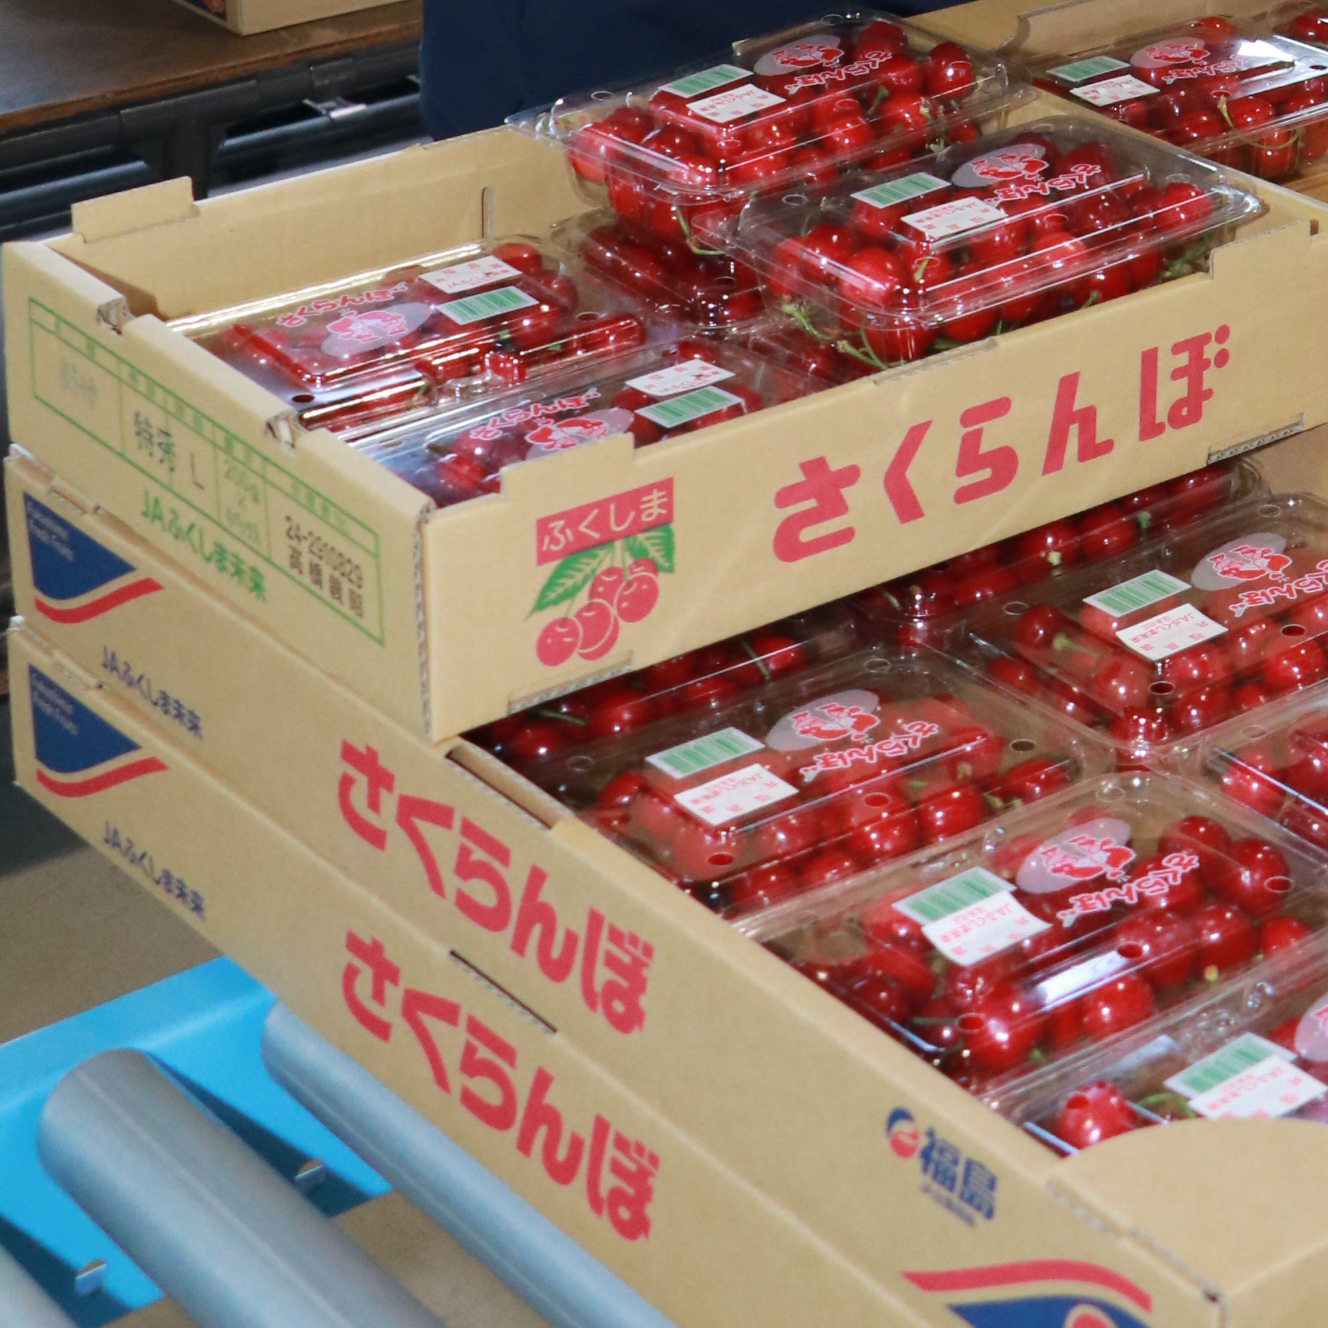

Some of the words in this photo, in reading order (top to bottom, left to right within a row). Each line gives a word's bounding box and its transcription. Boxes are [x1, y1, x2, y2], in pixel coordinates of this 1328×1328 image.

[785, 50, 892, 92] さくらんぼ
[986, 163, 1101, 204] さくらんぼ
[276, 282, 408, 327] さくらんぼ
[469, 389, 601, 440] さくらんぼ
[772, 324, 1230, 562] さくらんぼ
[141, 488, 267, 602] JAふくしま未来
[541, 487, 670, 551] ふくしま
[798, 721, 939, 778] さくらんぼ
[338, 739, 653, 1034] さくらんぼ
[1057, 851, 1200, 922] さくらんぼ
[342, 930, 660, 1242] さくらんぼ
[919, 1128, 996, 1219] 福島
